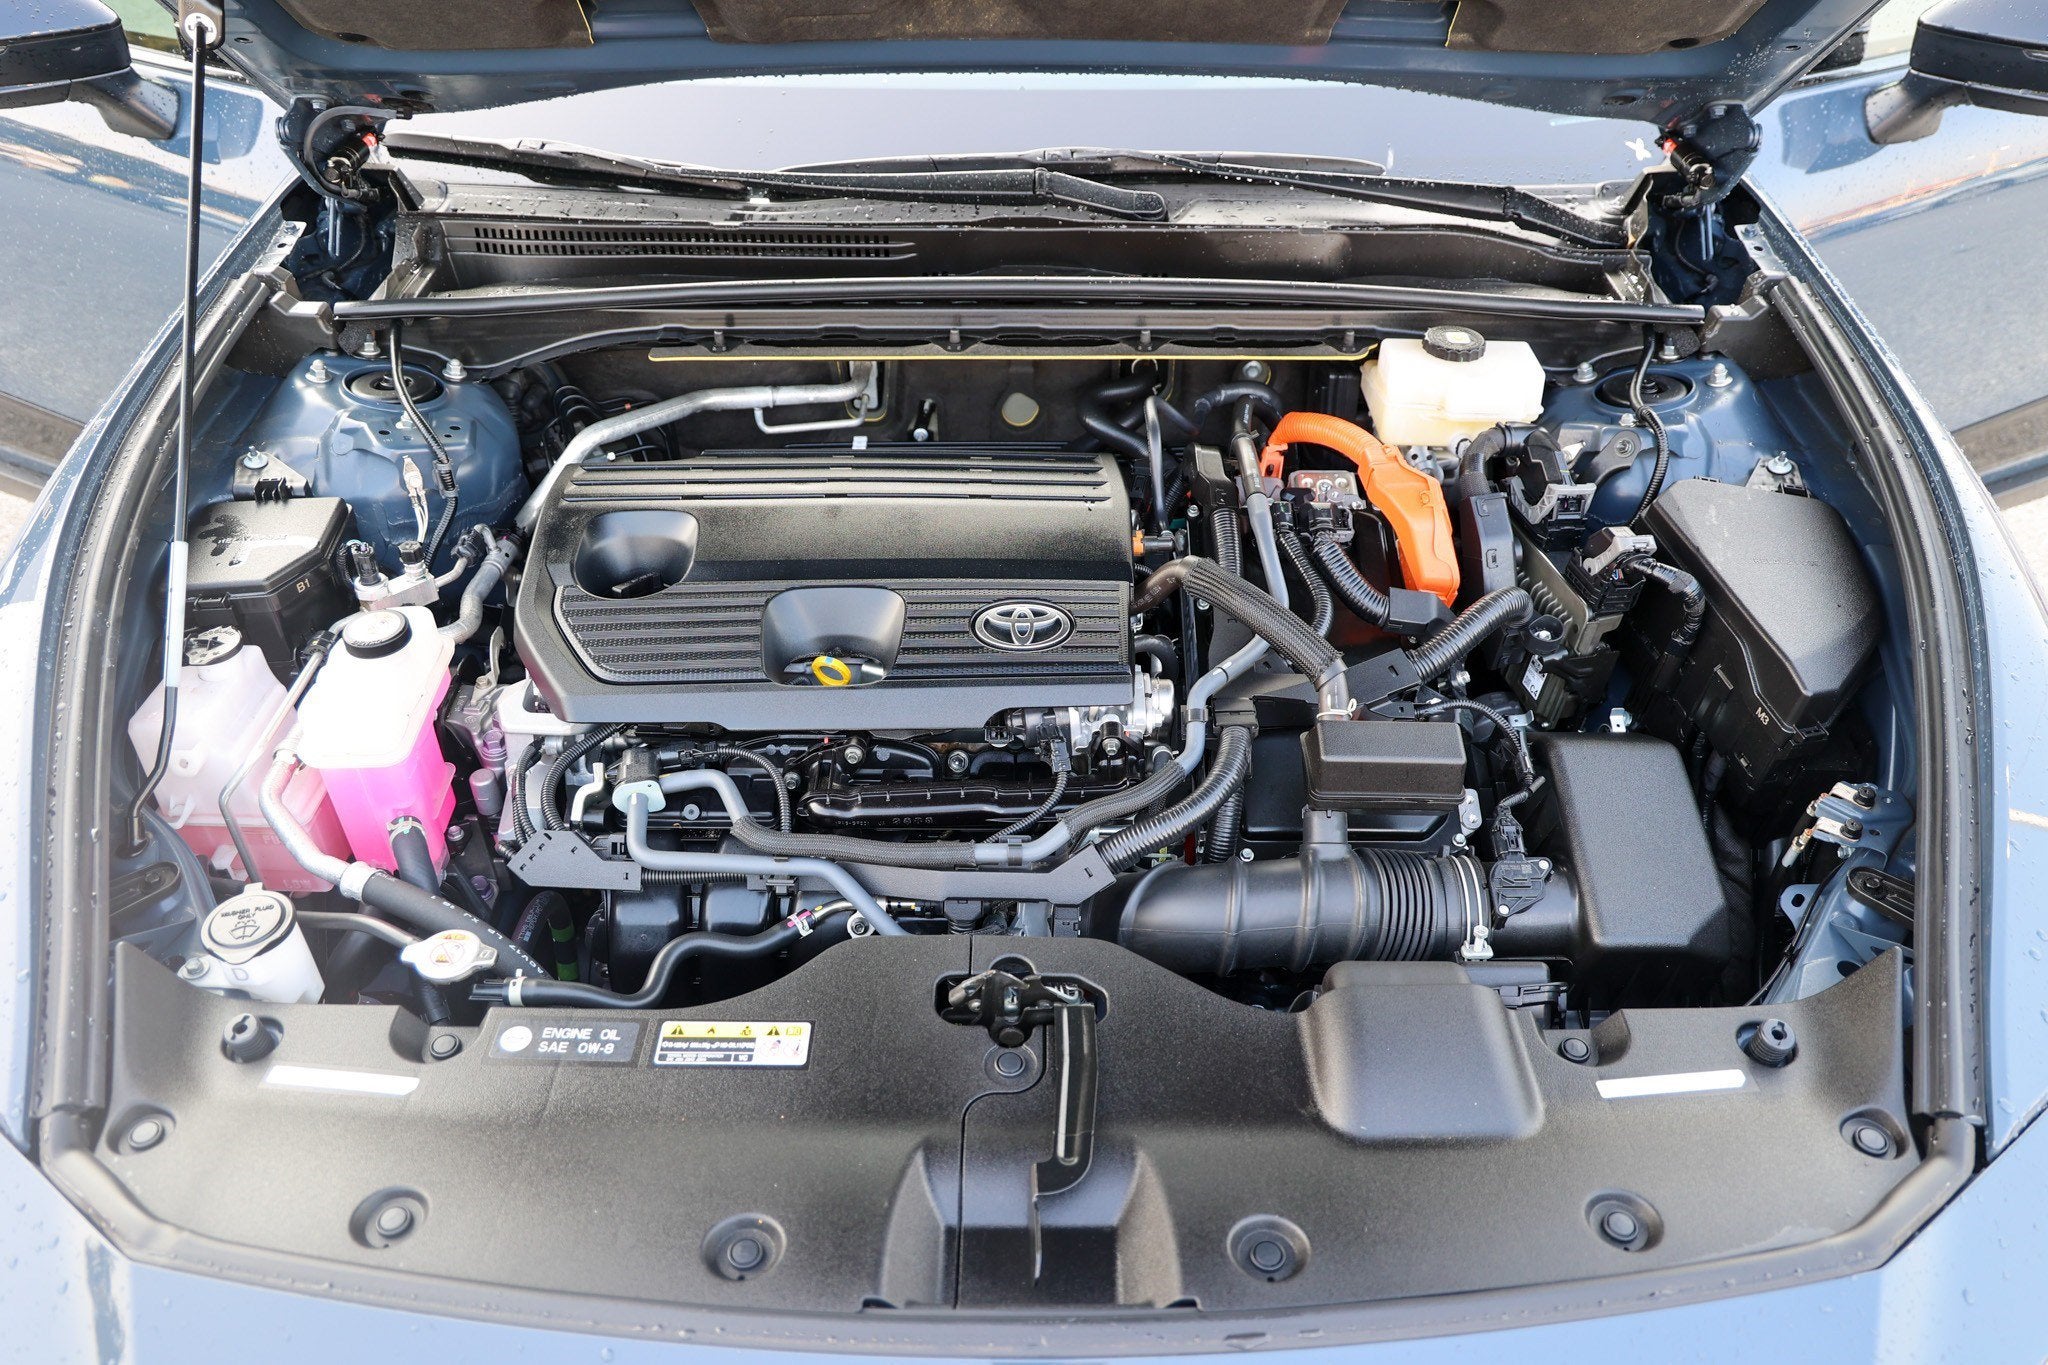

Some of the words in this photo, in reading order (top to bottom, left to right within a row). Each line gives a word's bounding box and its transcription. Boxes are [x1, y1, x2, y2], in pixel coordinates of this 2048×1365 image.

[296, 578, 311, 594] B1
[1755, 706, 1770, 725] M3
[541, 1027, 593, 1040] ENGINE
[600, 1028, 621, 1041] OIL
[538, 1041, 570, 1053] SAE
[577, 1041, 615, 1055] 0W-8
